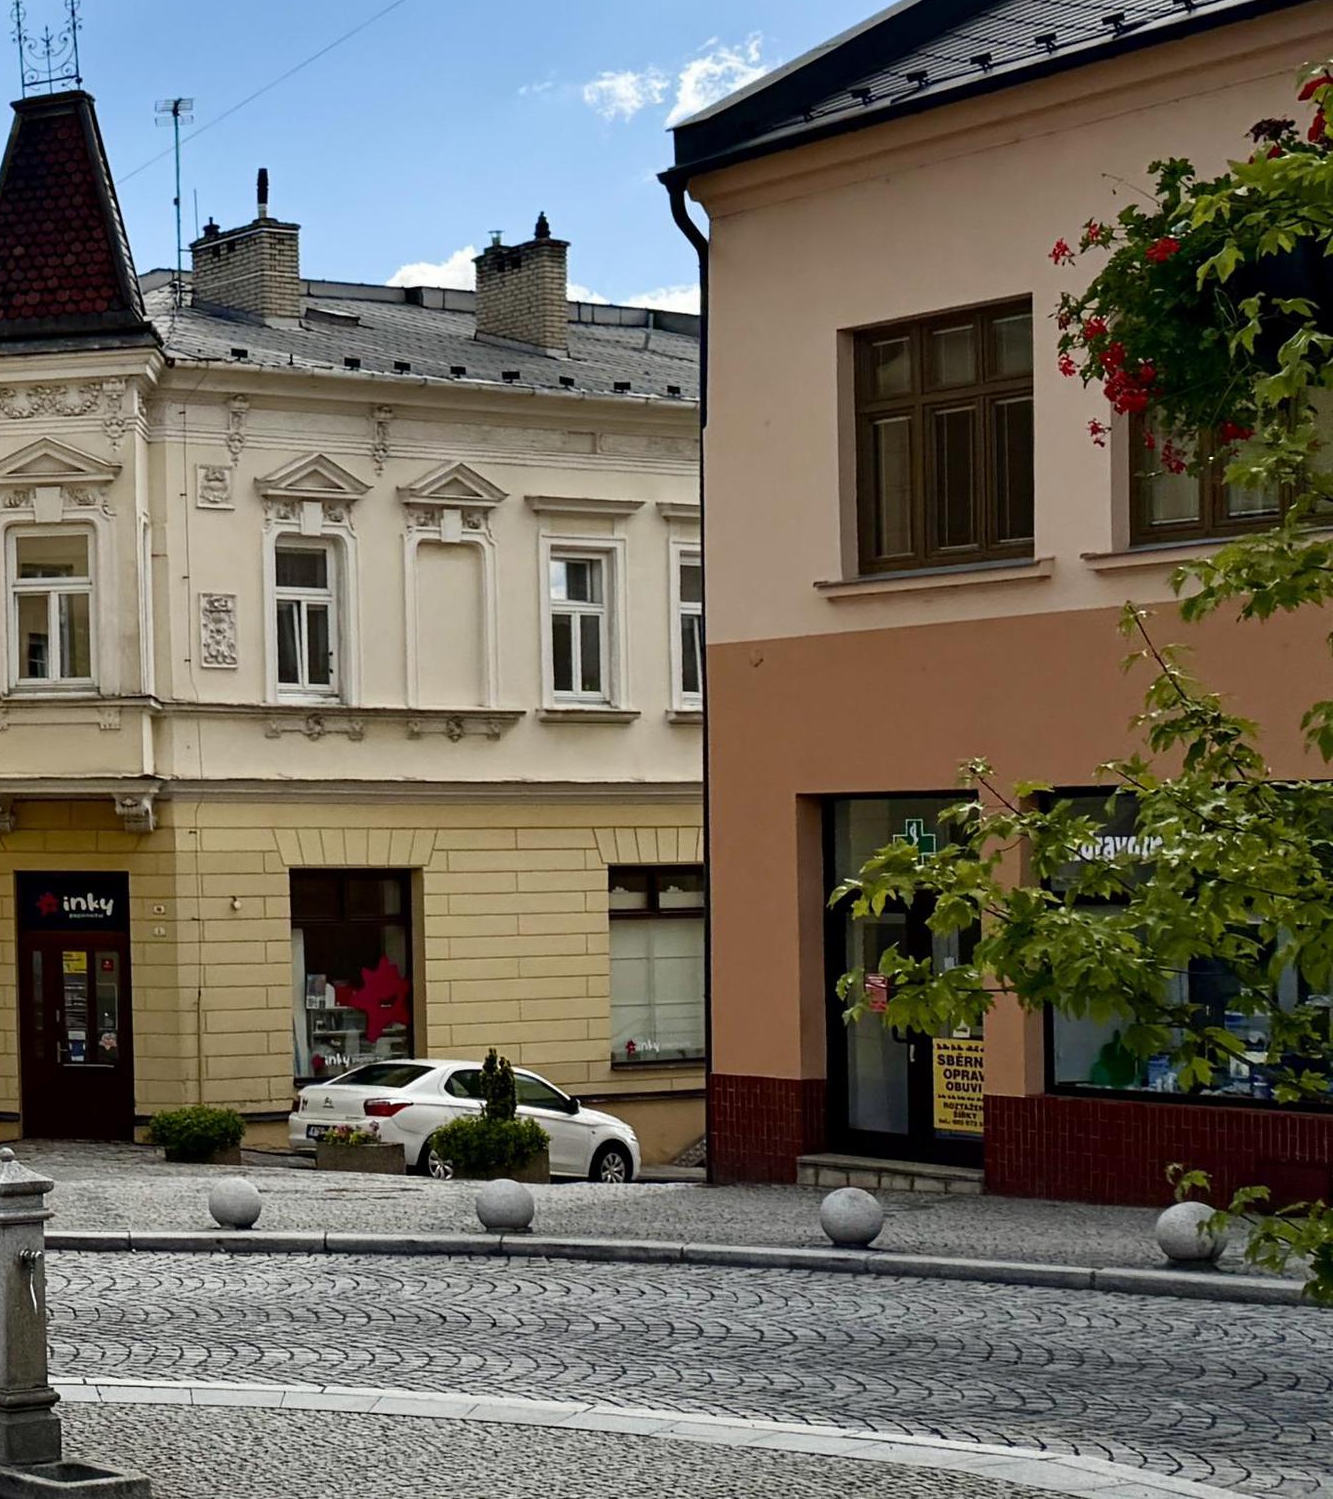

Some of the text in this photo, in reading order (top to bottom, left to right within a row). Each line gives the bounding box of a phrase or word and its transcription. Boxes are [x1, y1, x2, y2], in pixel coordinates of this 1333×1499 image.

[63, 892, 114, 916] inky
[324, 1052, 351, 1068] inky
[945, 1081, 982, 1094] OBUVI
